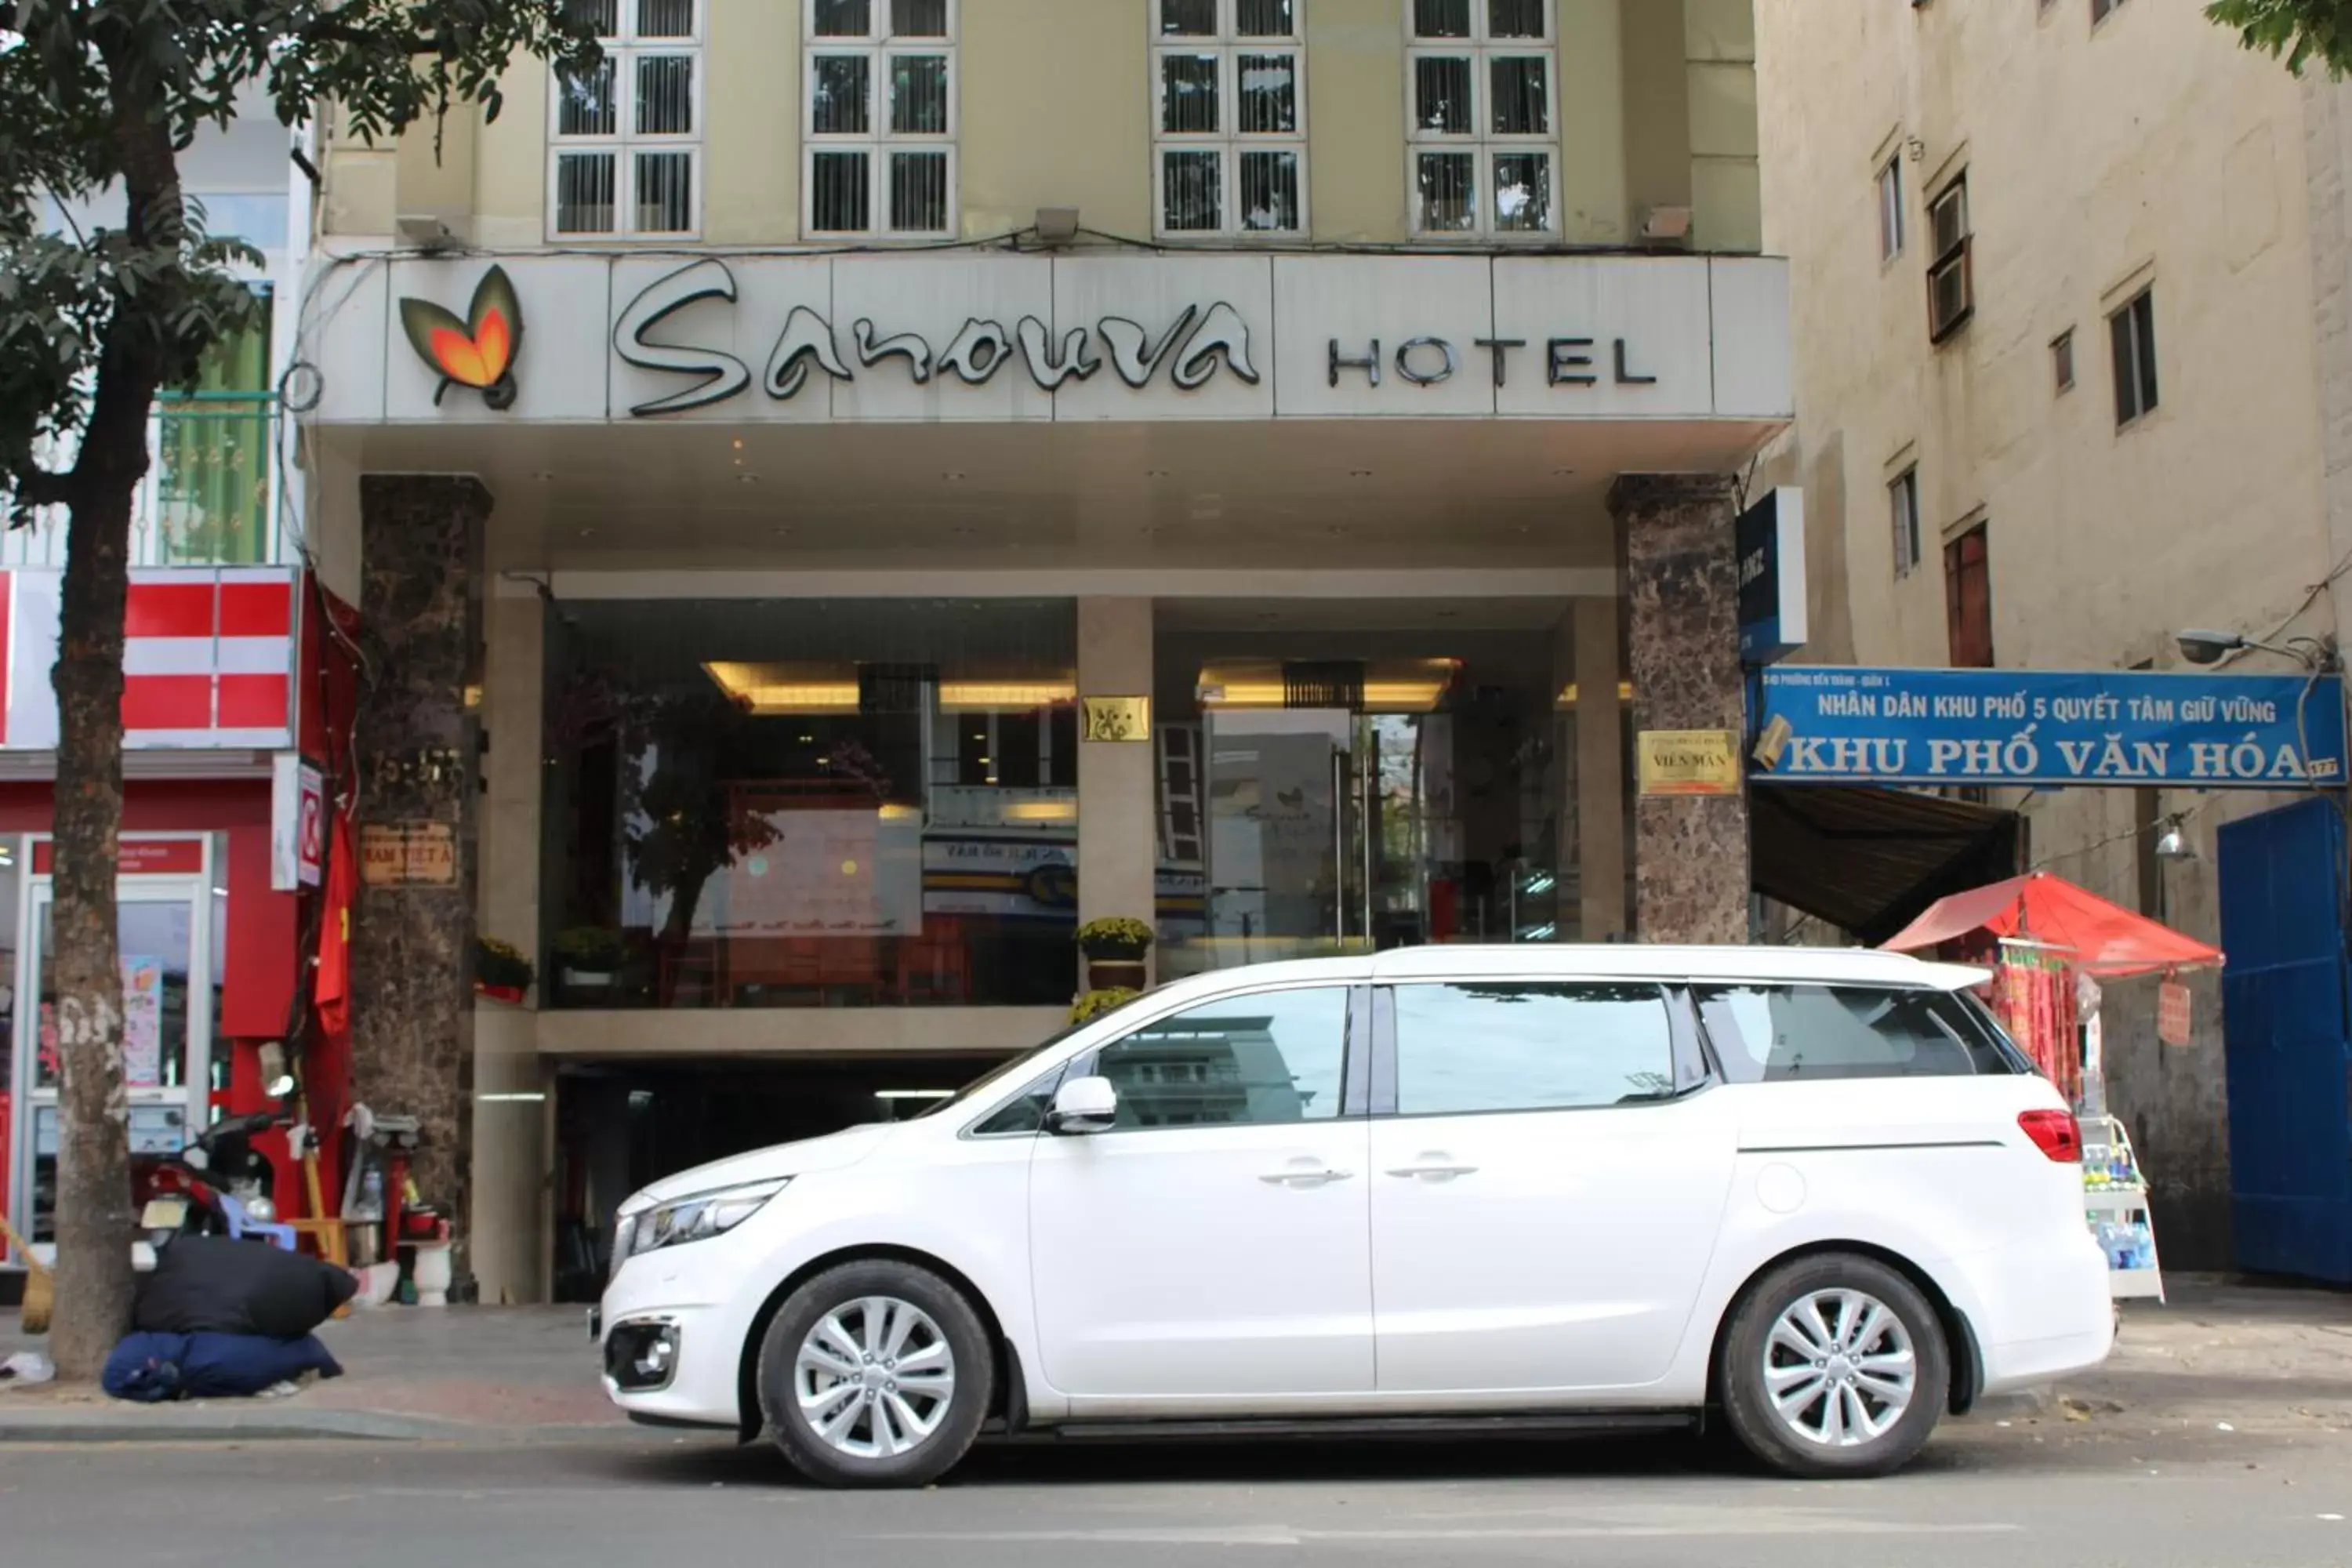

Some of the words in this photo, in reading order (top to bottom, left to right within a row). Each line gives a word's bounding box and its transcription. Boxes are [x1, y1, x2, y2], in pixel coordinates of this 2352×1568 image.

[613, 258, 1261, 417] Sanouva
[1328, 337, 1657, 388] HOTEL
[1818, 689, 1876, 717] NHÂN
[1883, 691, 1927, 717] DÂN
[1934, 695, 1976, 718] KHU
[1984, 689, 2027, 719] PHỐ
[2033, 697, 2047, 720] 5
[2053, 691, 2119, 723] QUYẾT
[2128, 695, 2175, 722] TÂM
[2180, 695, 2217, 722] GIỮ
[2220, 695, 2277, 723] VỮNG
[1788, 736, 1907, 773] KHU
[1927, 723, 2038, 775] PHỐ
[2056, 731, 2170, 776] VĂN
[2189, 731, 2308, 778] HÓA
